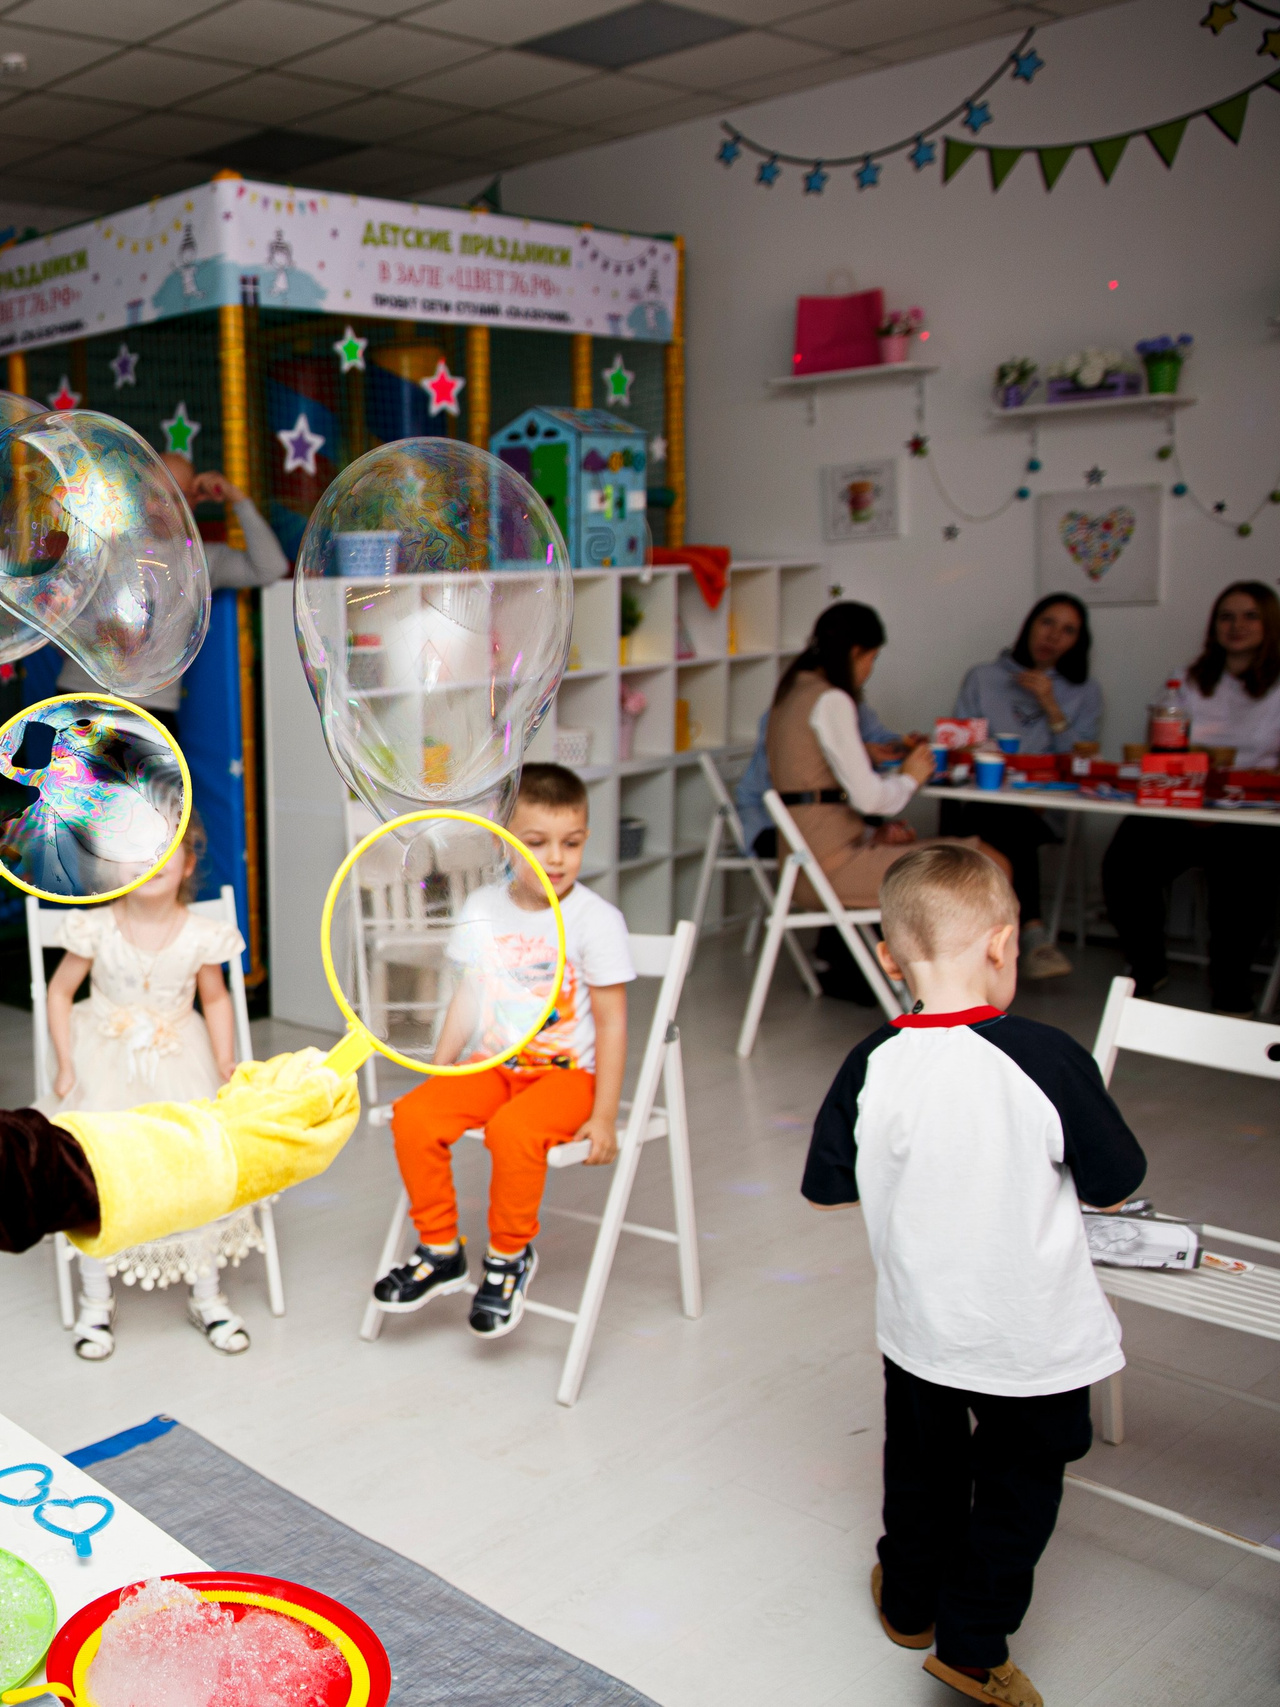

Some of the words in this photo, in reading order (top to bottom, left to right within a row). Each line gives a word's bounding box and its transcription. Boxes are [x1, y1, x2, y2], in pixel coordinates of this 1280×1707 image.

[361, 219, 453, 255] ДЕТСКИЕ
[460, 233, 571, 268] ПРАЗДНИКИ
[378, 260, 391, 284] В
[395, 261, 443, 290] ЗАЛЕ
